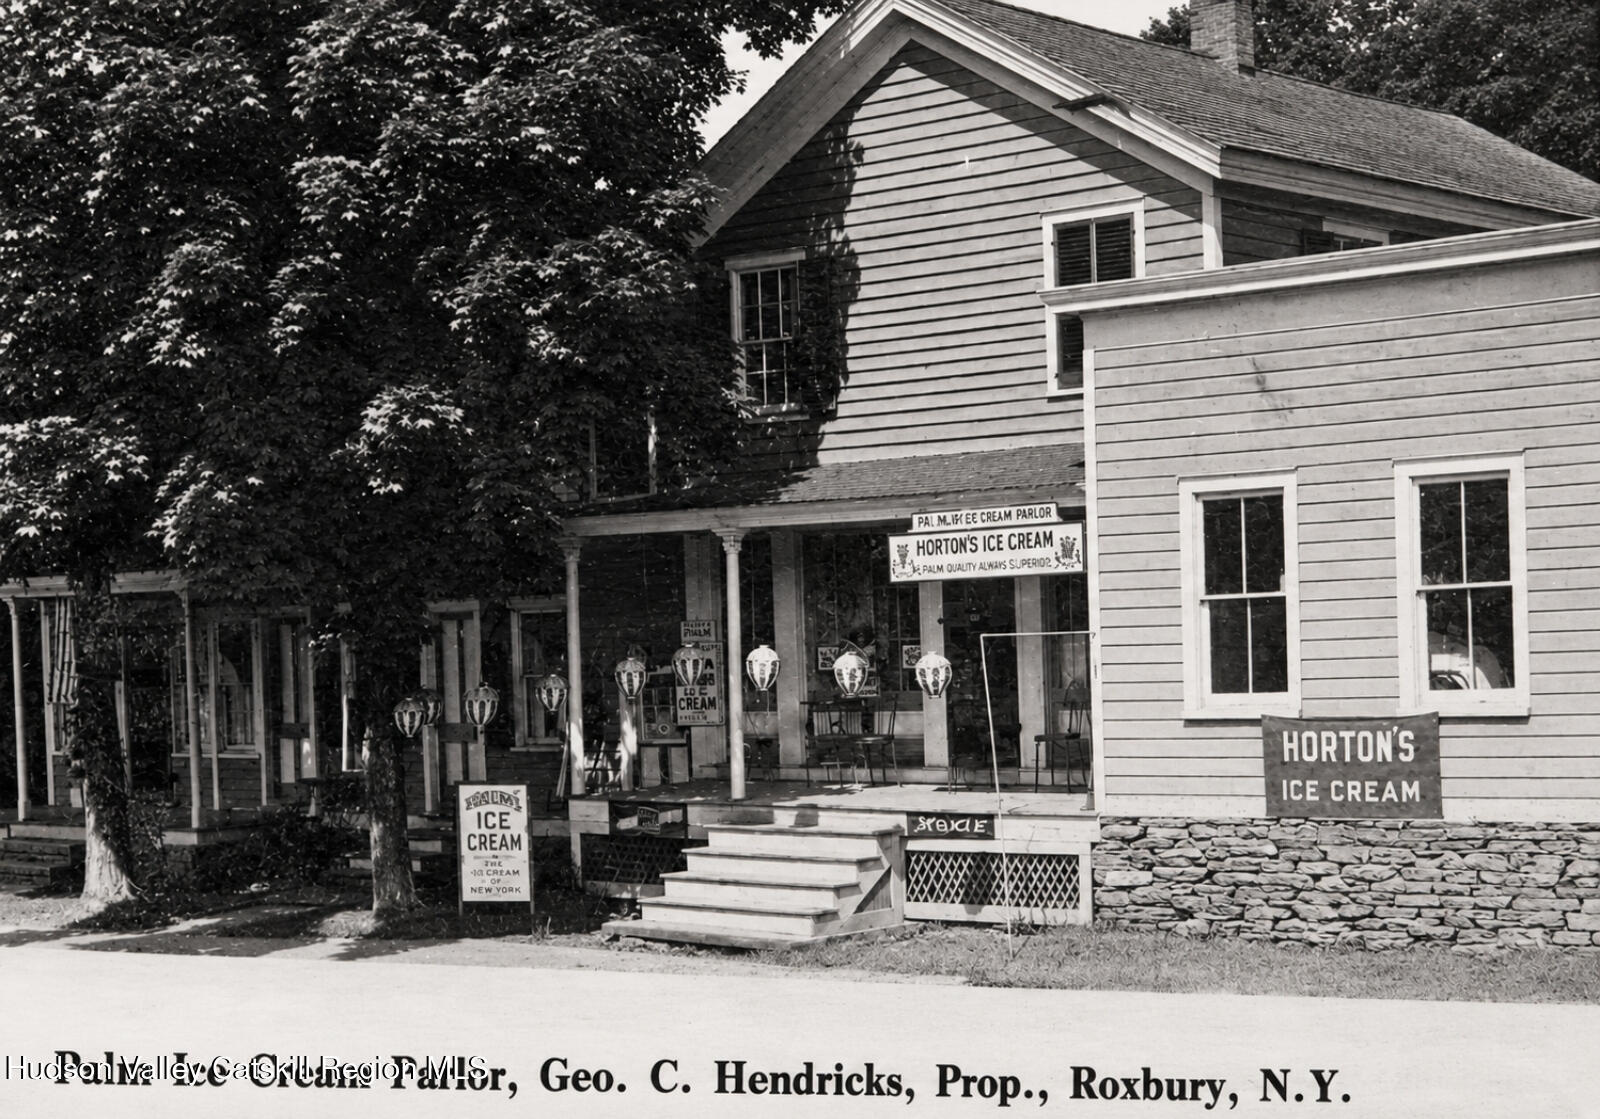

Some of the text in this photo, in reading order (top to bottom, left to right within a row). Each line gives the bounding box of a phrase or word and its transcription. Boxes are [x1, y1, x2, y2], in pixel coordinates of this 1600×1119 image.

[980, 510, 1012, 524] CREAM
[1016, 506, 1052, 520] PARLOR
[916, 530, 1054, 556] HORTON'S ICE CREAM
[922, 564, 944, 574] PALM
[946, 562, 977, 573] QUALITY
[978, 560, 1007, 571] ALWAYS
[679, 696, 717, 711] CREAM
[1282, 725, 1415, 763] HORTON'S
[1282, 779, 1420, 802] ICE CREAM
[477, 811, 511, 830] ICE
[467, 833, 522, 851] CREAM
[486, 869, 520, 877] CREAM
[470, 886, 521, 894] NEW YORK
